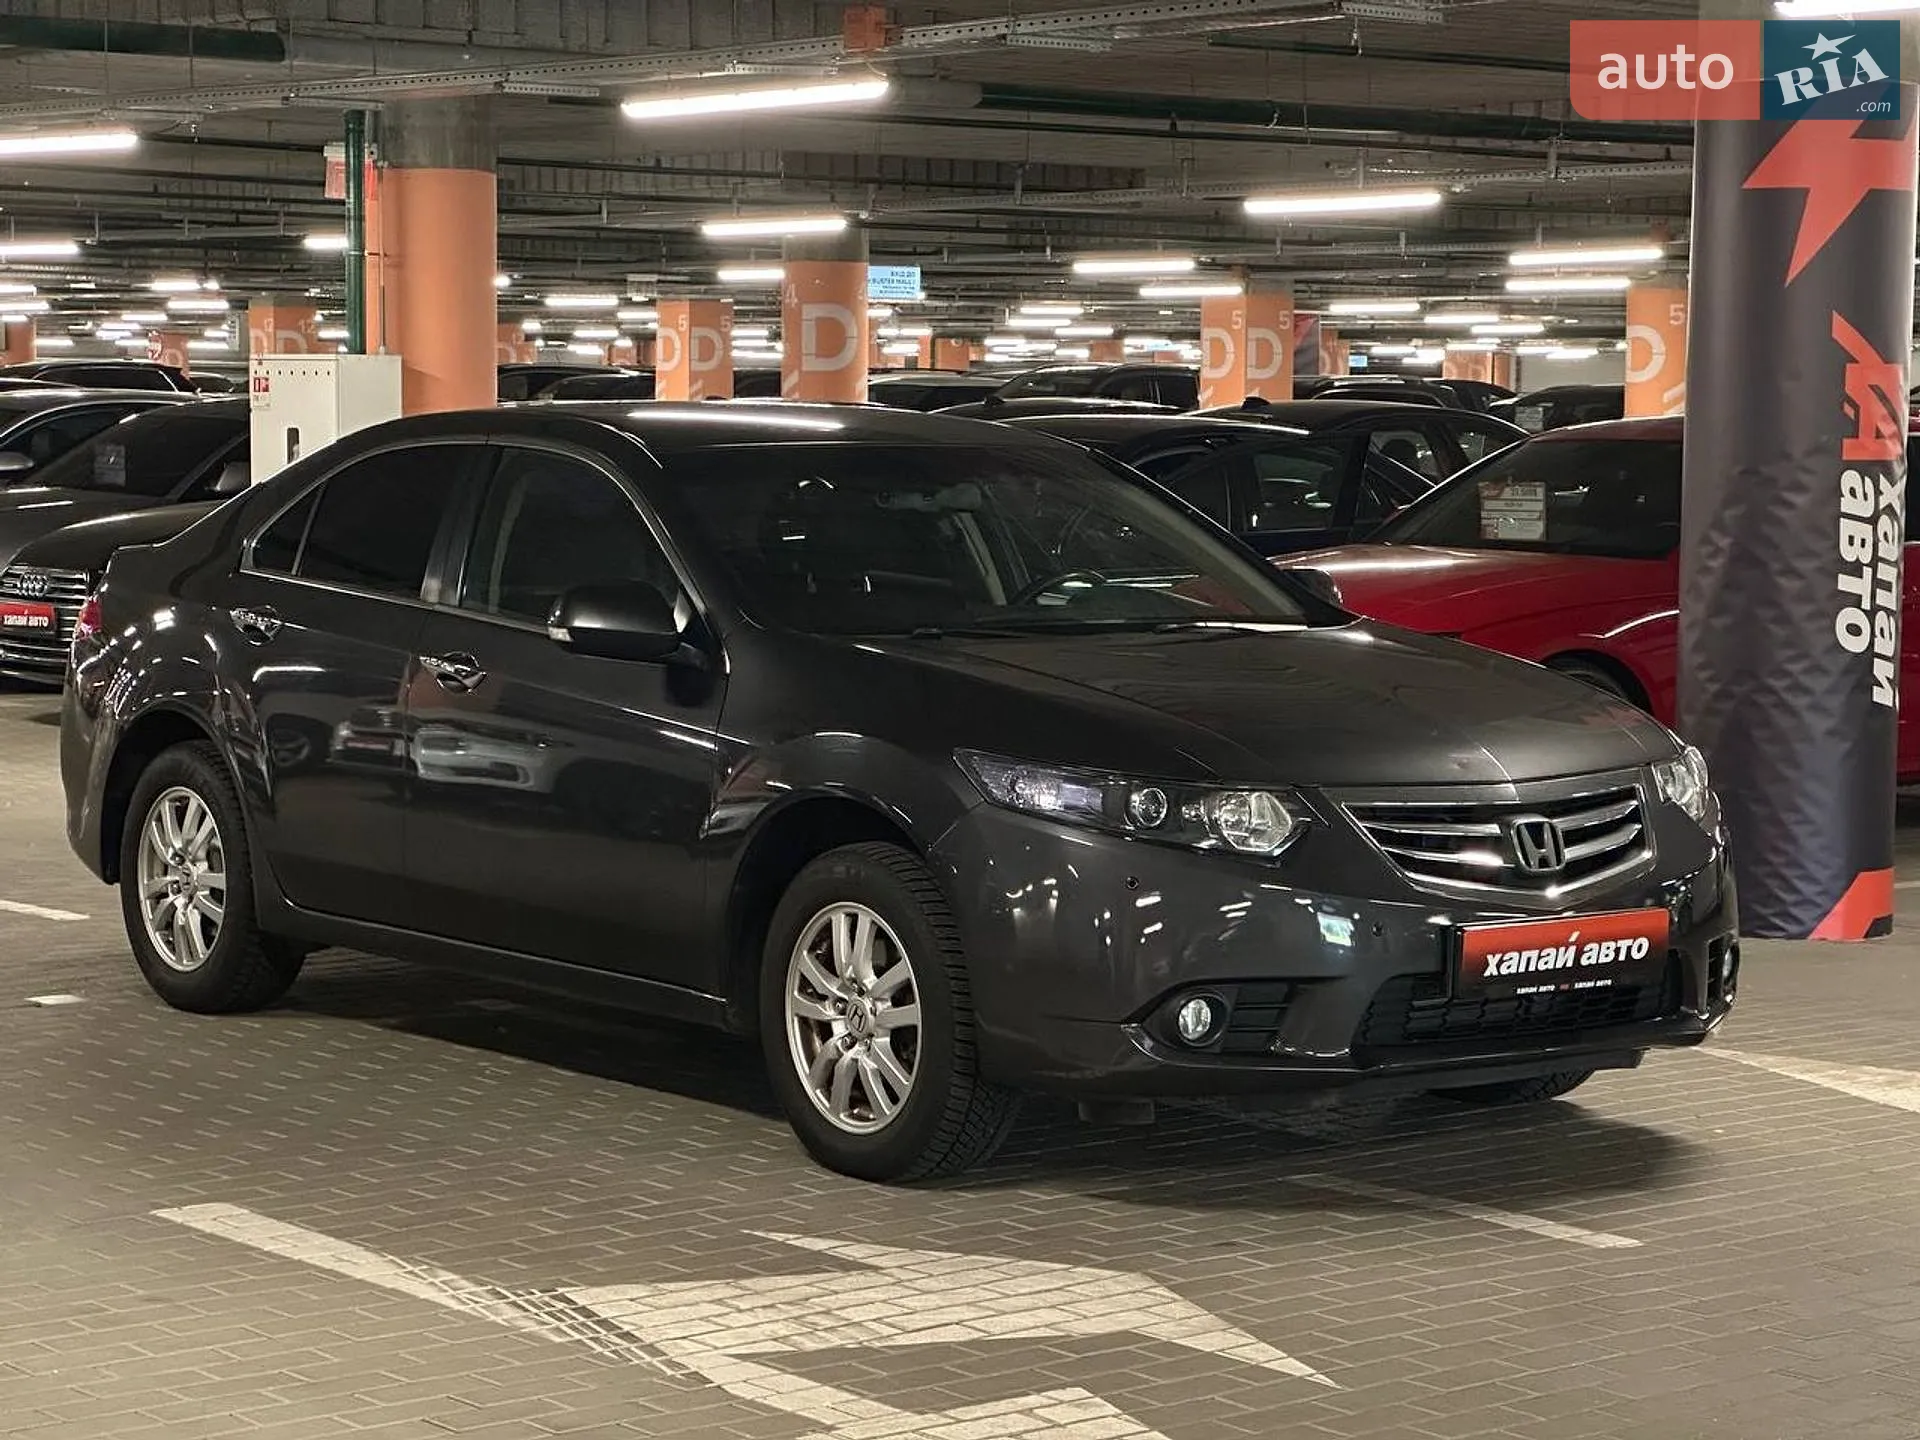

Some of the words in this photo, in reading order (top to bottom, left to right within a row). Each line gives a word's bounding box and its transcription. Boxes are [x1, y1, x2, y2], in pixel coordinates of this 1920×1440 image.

[678, 314, 687, 332] 5
[719, 316, 732, 332] 5
[802, 303, 858, 371] D
[1231, 310, 1242, 330] 5
[1279, 310, 1290, 330] 5
[1669, 304, 1685, 325] 5
[657, 327, 681, 372] D
[691, 327, 723, 371] D
[1203, 327, 1234, 379] D
[1247, 327, 1283, 379] D
[1627, 325, 1666, 383] D
[1835, 469, 1875, 654] авто
[1483, 930, 1580, 977] хапай
[1580, 937, 1650, 967] авто
